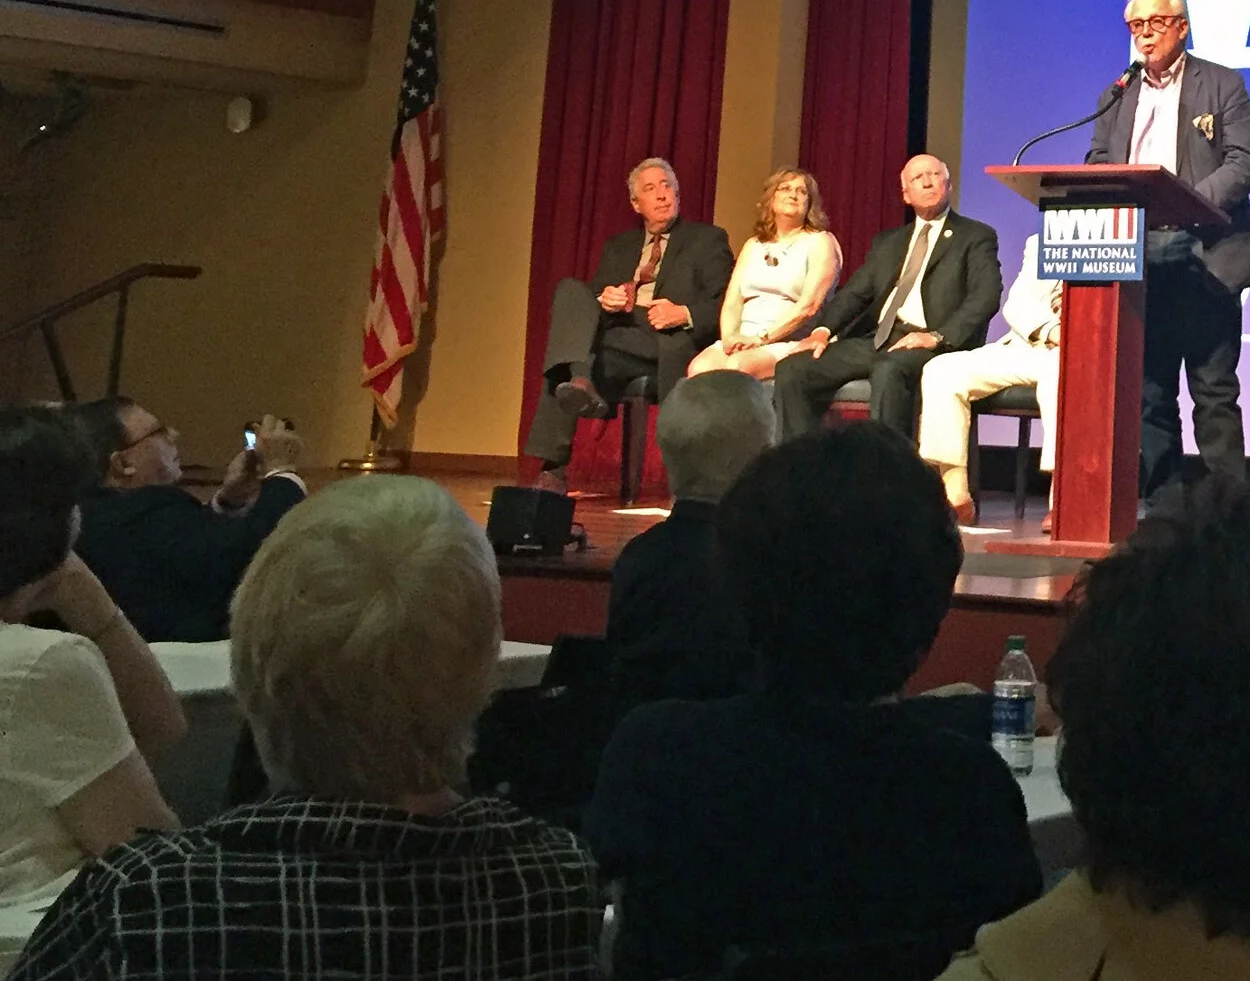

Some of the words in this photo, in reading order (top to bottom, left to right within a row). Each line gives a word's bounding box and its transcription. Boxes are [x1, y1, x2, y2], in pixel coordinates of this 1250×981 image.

[1044, 208, 1137, 244] WWII
[1043, 247, 1069, 260] THE
[1071, 246, 1137, 260] NATIONAL
[1043, 261, 1078, 274] WWII
[1082, 261, 1137, 274] MUSEUM
